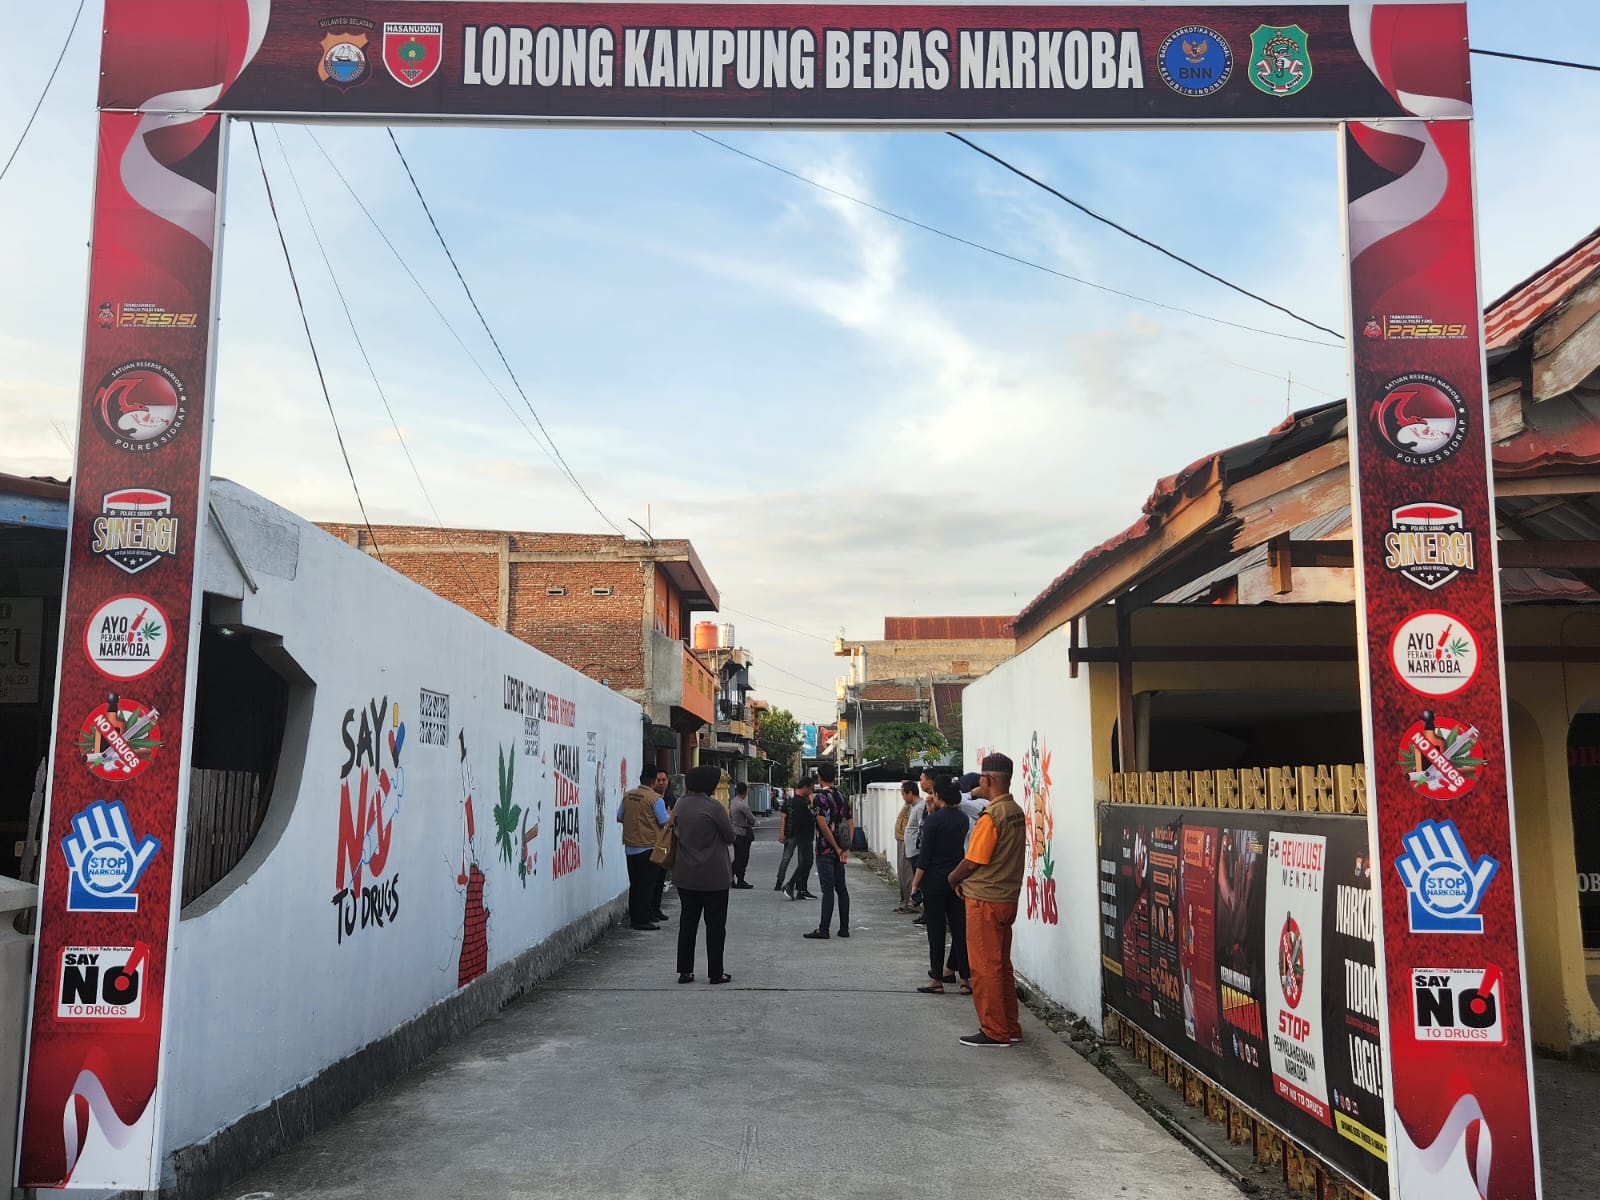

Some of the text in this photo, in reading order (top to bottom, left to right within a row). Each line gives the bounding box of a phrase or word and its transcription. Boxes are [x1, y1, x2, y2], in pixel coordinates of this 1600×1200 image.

[386, 24, 440, 34] HASANUDDIN
[464, 27, 1144, 90] LORONG KAMPUNG BEBAS NARKOBA
[1178, 67, 1213, 80] BNN
[119, 313, 197, 325] PRESISI
[1387, 325, 1467, 336] PRESISI
[111, 362, 135, 377] SATUAN
[1384, 375, 1408, 390] SATUAN
[115, 406, 186, 451] POLRES SIDRAP
[1396, 419, 1467, 464] POLRES SIDRAP
[92, 516, 178, 555] SINERGI
[1385, 531, 1474, 570] SINERGI
[101, 616, 127, 634] AYO
[100, 634, 127, 642] PERANGI
[1407, 633, 1433, 650] AYO
[99, 642, 150, 657] NARKOBA
[1407, 650, 1434, 658] PERANGI
[1407, 659, 1461, 674] NARKOBA
[93, 713, 140, 769] NO DRUGS
[340, 696, 389, 779] SAY
[1411, 732, 1465, 788] NO DRUGS
[553, 771, 580, 807] TIDAK
[554, 807, 580, 851] PADA
[90, 858, 125, 870] STOP
[552, 839, 581, 881] NARKOBA
[1281, 840, 1323, 872] REVOLUSI
[1282, 869, 1318, 892] MENTAL
[1427, 877, 1465, 889] STOP
[332, 872, 399, 946] TO DRUGS
[65, 953, 99, 965] SAY
[1344, 958, 1379, 1021] TIDAK
[1415, 975, 1450, 987] SAY
[67, 1006, 127, 1016] TO DRUGS
[1278, 1009, 1310, 1042] STOP
[1425, 1029, 1488, 1038] TO DRUGS
[1348, 1033, 1383, 1098] LAGI!
